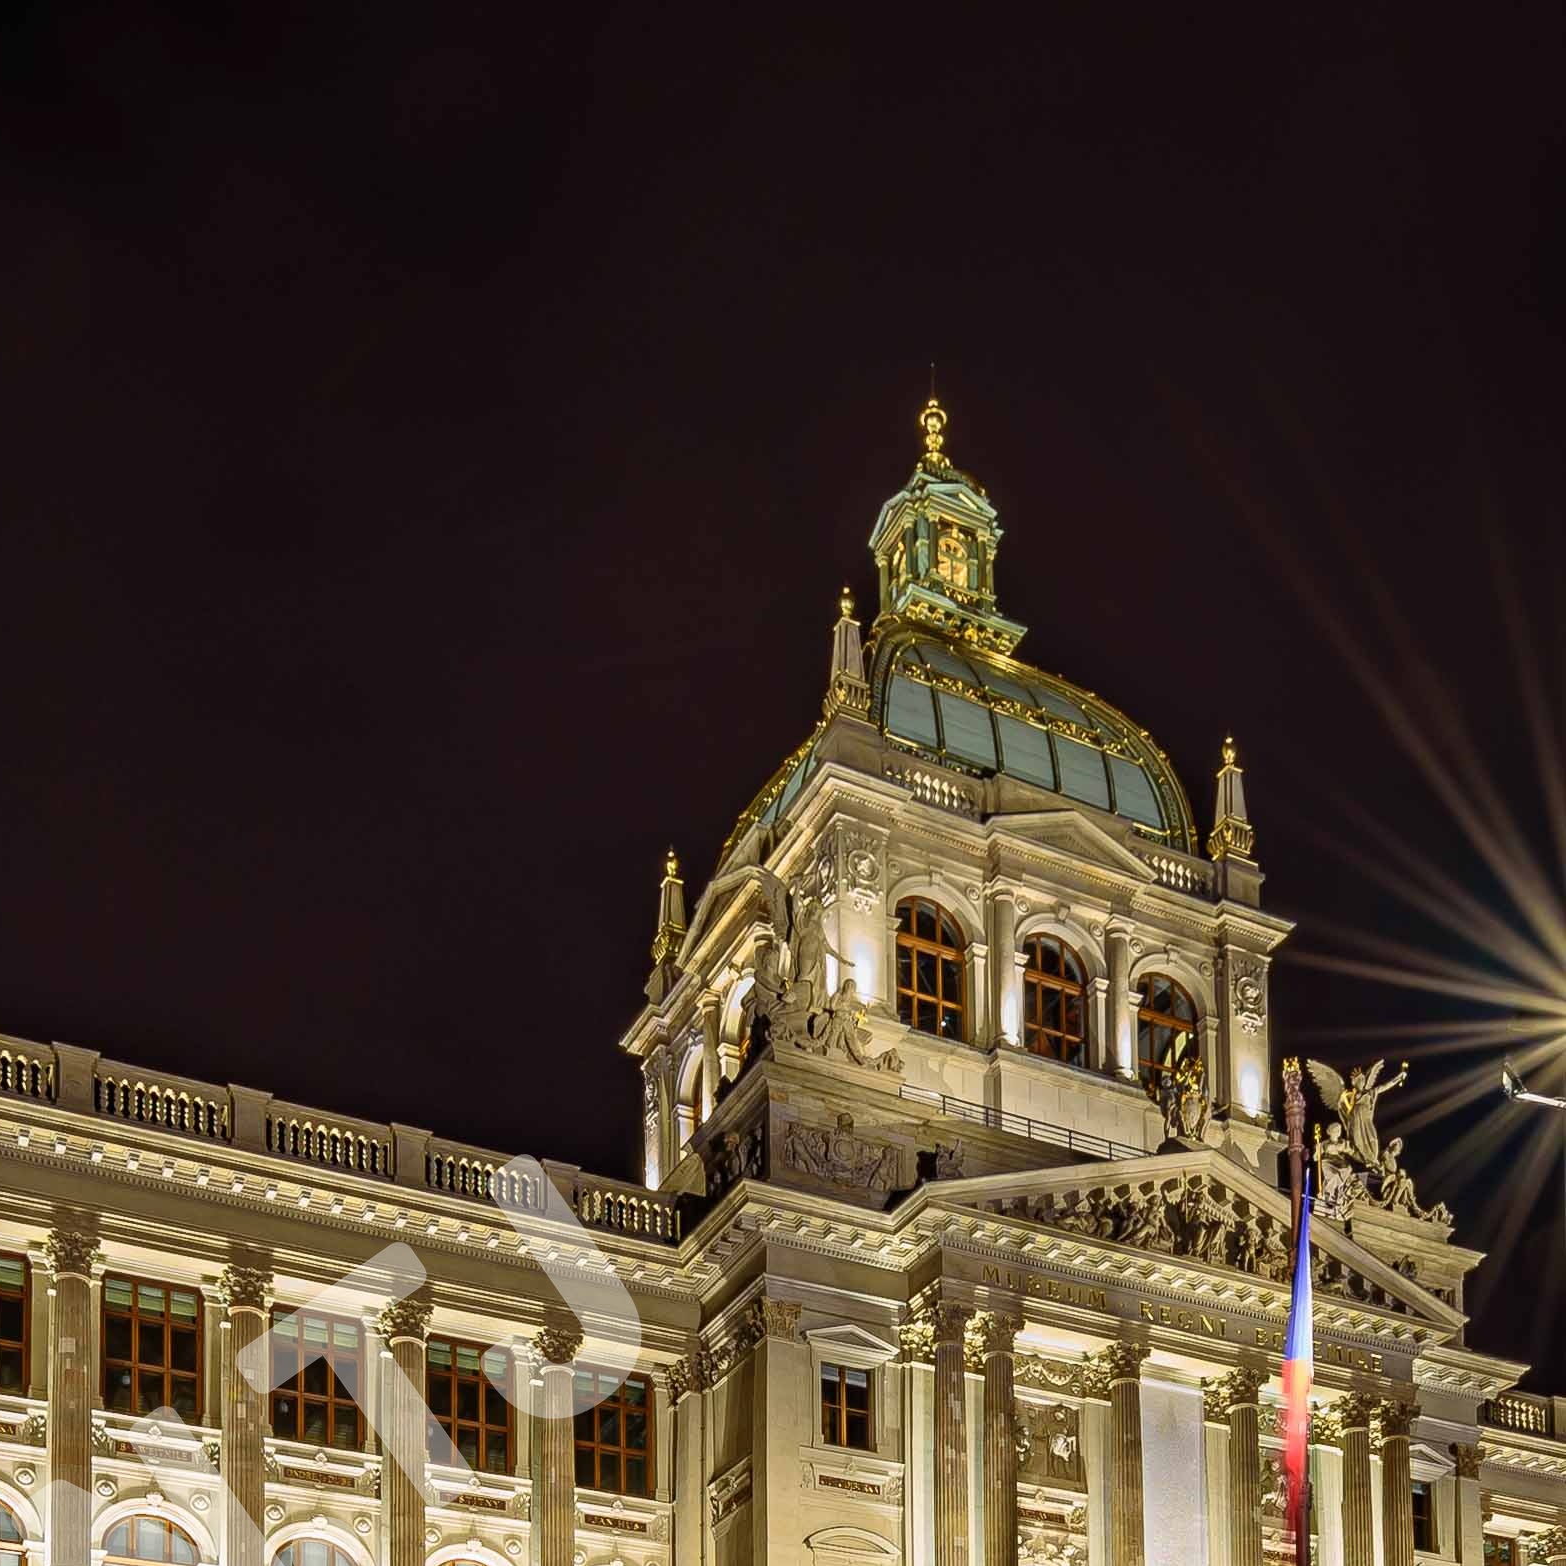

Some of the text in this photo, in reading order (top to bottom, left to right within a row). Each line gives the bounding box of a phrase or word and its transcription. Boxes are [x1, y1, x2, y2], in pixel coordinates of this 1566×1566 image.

[982, 1263, 1383, 1373] MUSEUM REGNI BOEMIAE
